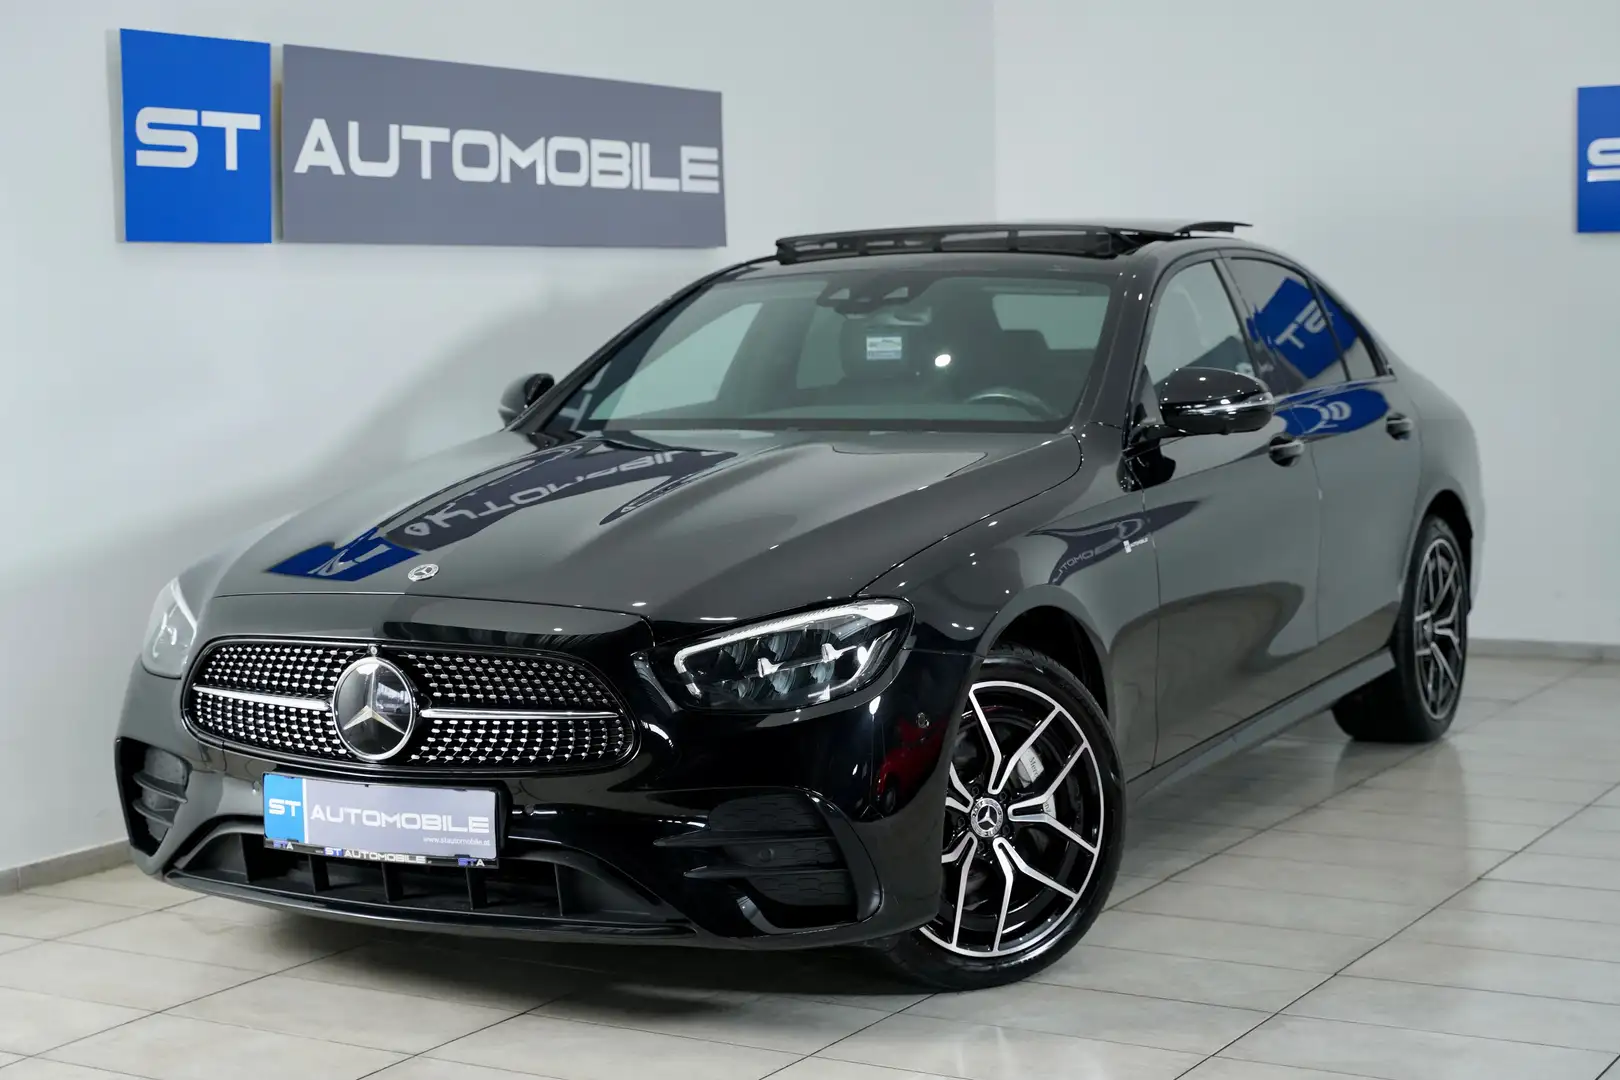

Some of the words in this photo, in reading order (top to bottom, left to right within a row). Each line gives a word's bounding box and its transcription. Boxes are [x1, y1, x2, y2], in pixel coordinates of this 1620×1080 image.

[135, 106, 261, 171] ST
[293, 118, 720, 193] AUTOMOBILE
[1587, 137, 1620, 182] S
[268, 798, 301, 817] ST
[310, 804, 490, 833] AUTOMOBILE
